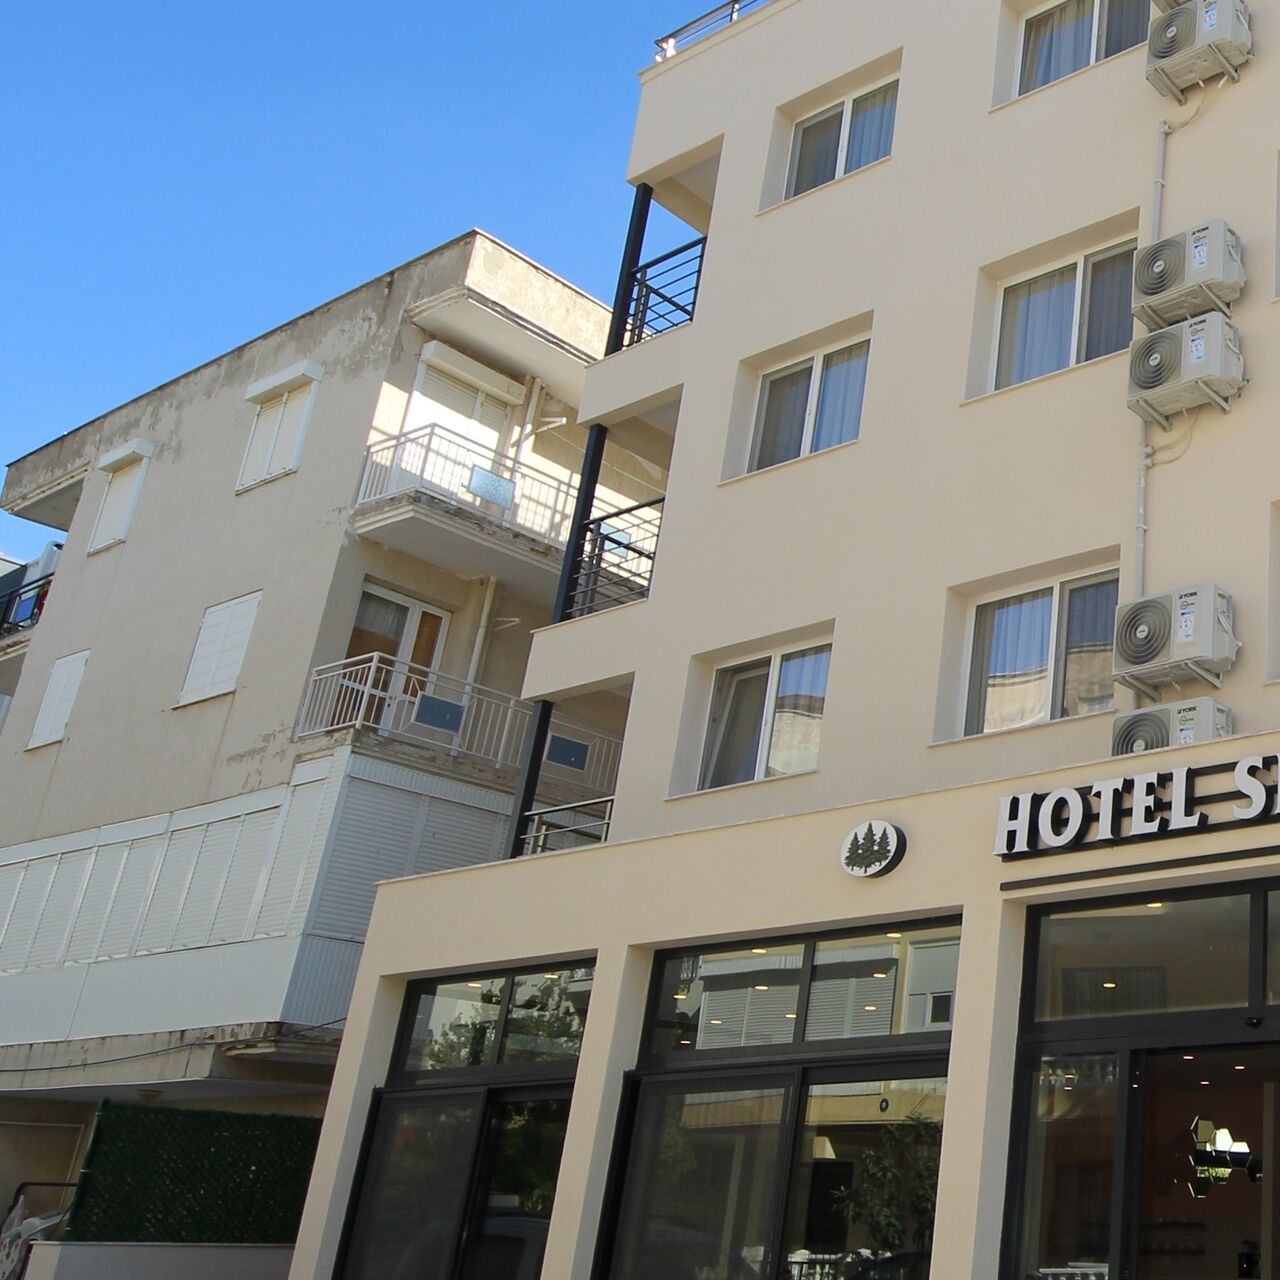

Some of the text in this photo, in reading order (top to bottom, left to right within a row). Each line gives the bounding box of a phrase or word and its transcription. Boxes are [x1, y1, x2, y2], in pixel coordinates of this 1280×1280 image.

[1183, 591, 1198, 599] YORK
[1182, 705, 1198, 713] YORK
[992, 767, 1203, 855] HOTEL
